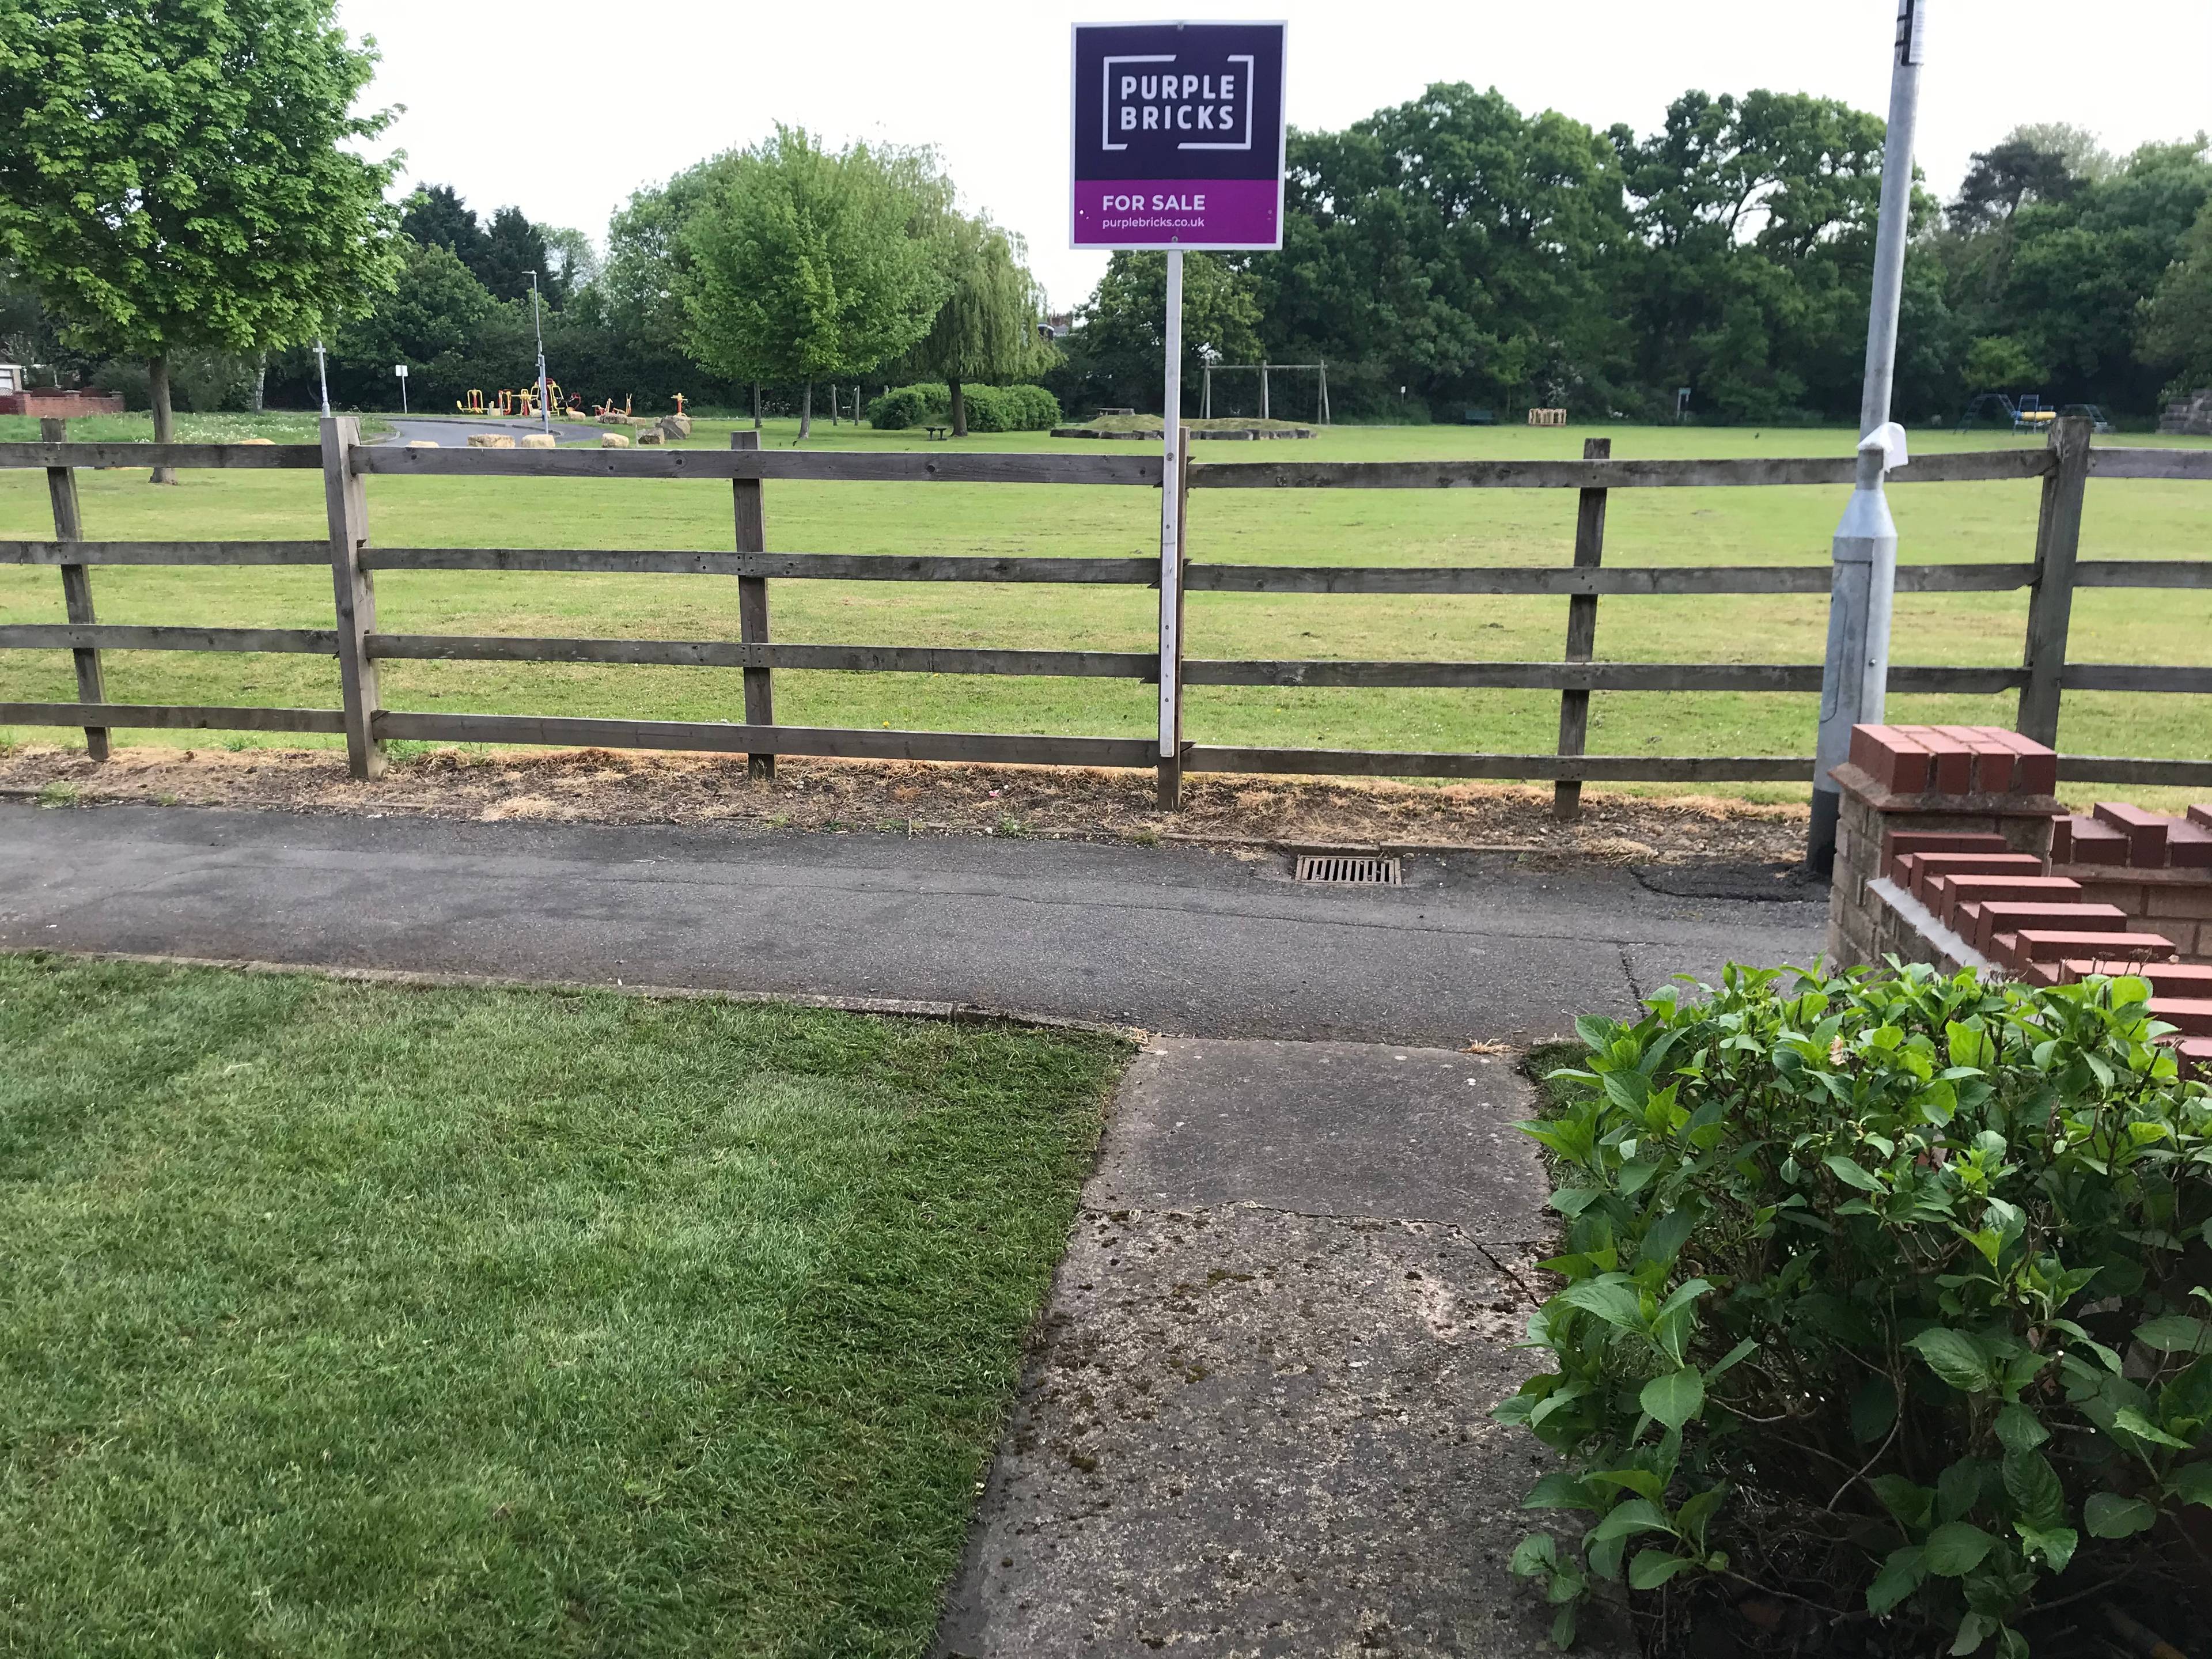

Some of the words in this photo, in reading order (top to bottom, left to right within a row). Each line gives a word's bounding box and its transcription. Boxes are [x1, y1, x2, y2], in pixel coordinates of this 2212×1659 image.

[1121, 75, 1234, 100] PURPLE
[1120, 105, 1234, 130] BRICKS
[1103, 195, 1145, 211] FOR
[1152, 194, 1206, 211] SALE
[1102, 217, 1205, 229] purplebricks.co.uk
